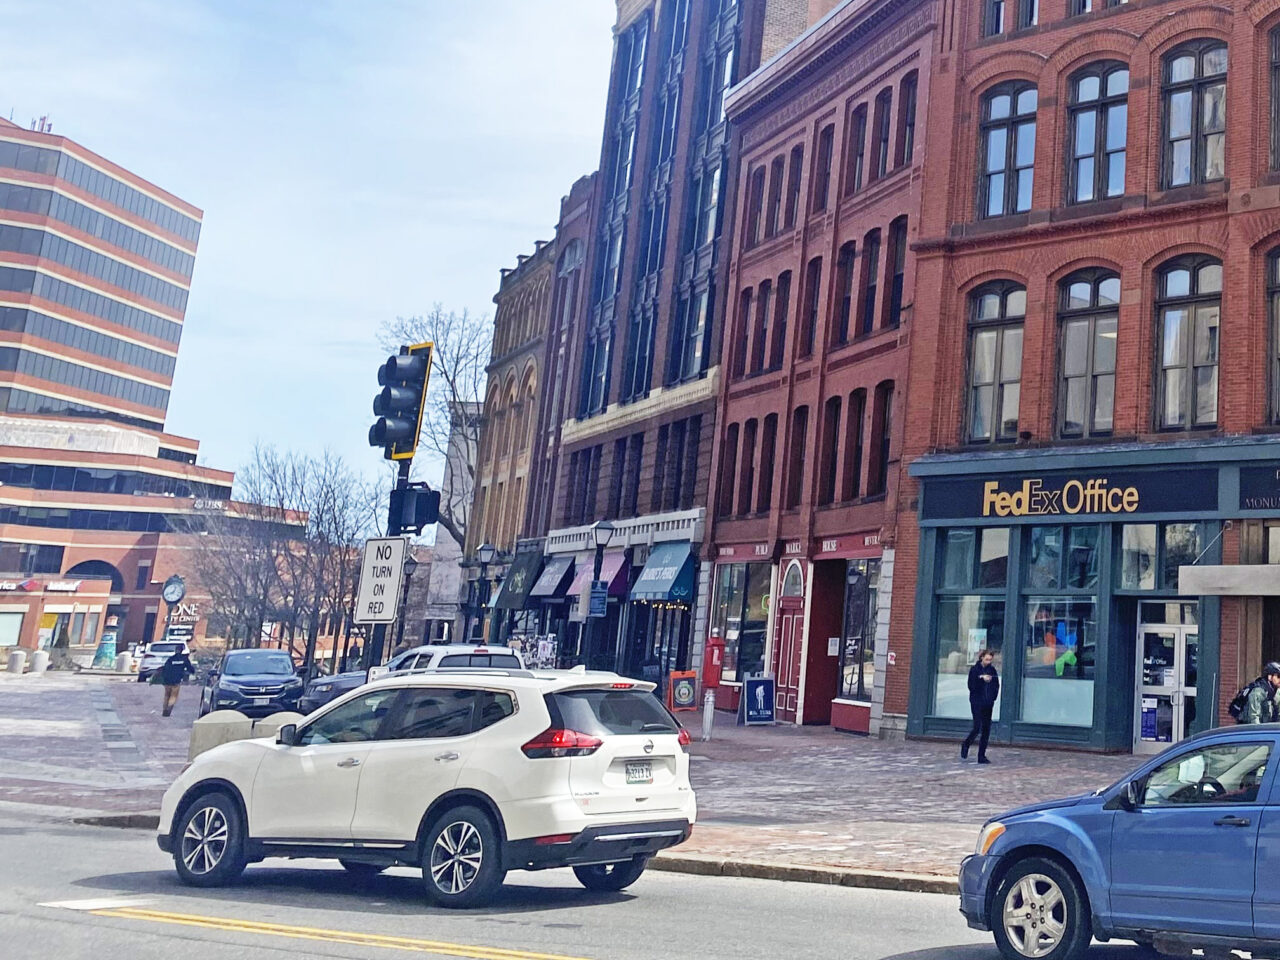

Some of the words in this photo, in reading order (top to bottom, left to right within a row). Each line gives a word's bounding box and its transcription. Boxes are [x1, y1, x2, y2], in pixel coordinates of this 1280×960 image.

[983, 478, 1061, 516] FedEx
[1062, 478, 1139, 514] Office
[376, 545, 392, 560] NO
[372, 566, 392, 578] TURN
[373, 584, 385, 596] ON
[367, 601, 384, 614] RED
